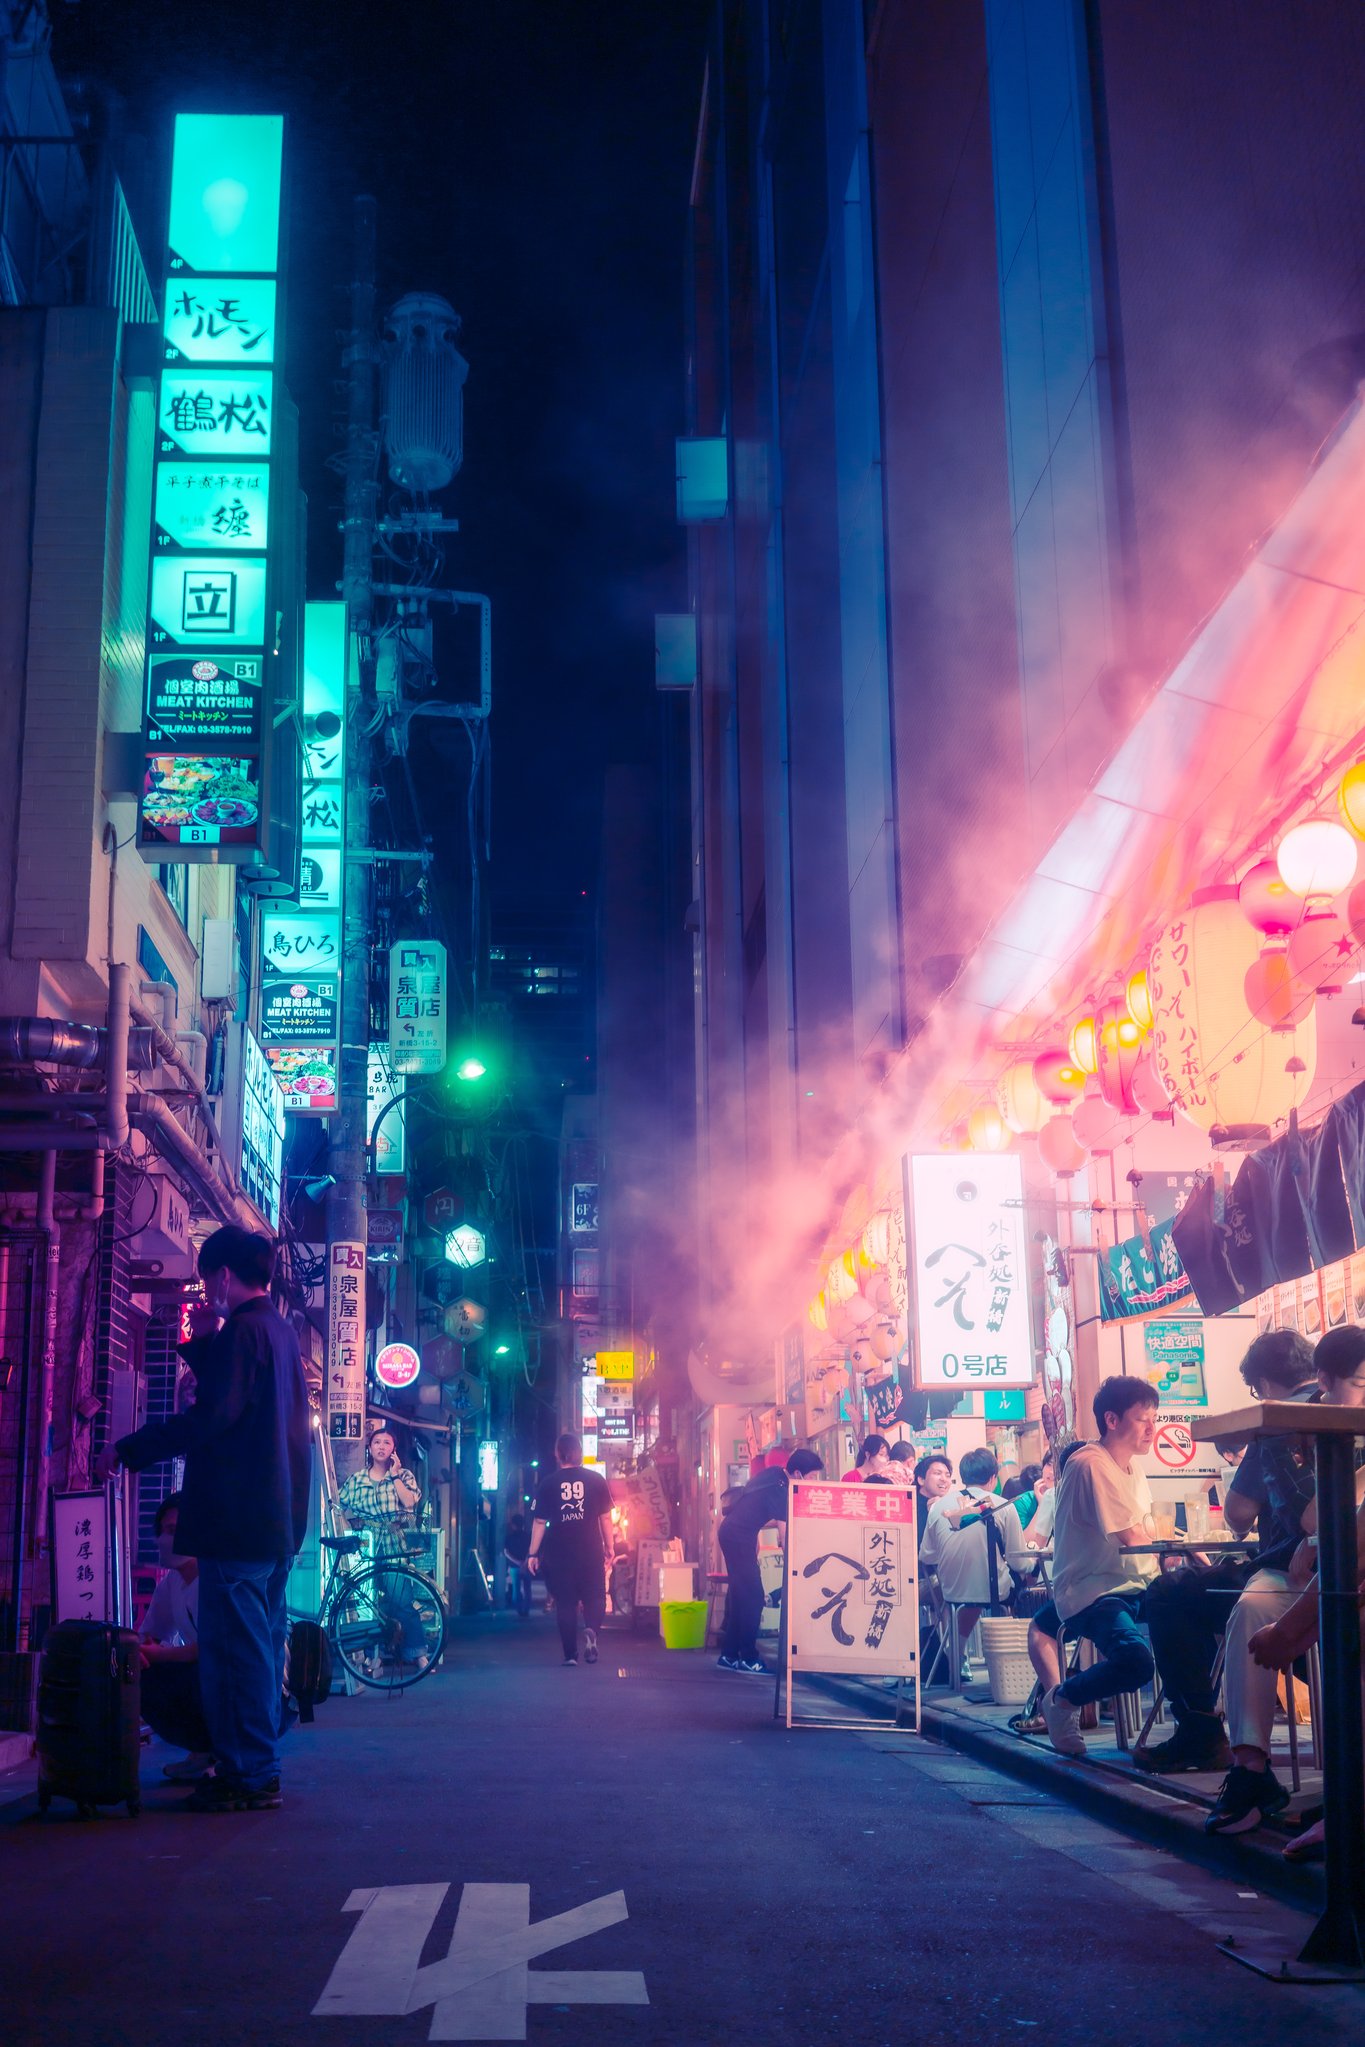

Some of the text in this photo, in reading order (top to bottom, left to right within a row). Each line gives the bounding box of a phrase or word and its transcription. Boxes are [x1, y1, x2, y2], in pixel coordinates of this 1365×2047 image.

[174, 290, 269, 350] ホルモン
[166, 390, 268, 436] 鶴松
[212, 498, 252, 538] 纏
[187, 582, 228, 620] 立
[236, 664, 256, 676] B1
[165, 680, 240, 695] 個室肉酒場
[156, 696, 254, 709] MEAT KITCHEN
[178, 711, 229, 721] ミートキッチン
[149, 730, 163, 740] B1
[191, 829, 208, 841] B1
[269, 931, 335, 957] 鳥ひろ
[319, 986, 332, 995] B1
[397, 976, 440, 994] 泉屋
[267, 1008, 331, 1017] MEAT KITCHEN
[396, 997, 440, 1018] 質店
[291, 1096, 303, 1106] B1
[987, 1218, 1014, 1283] 外呑処
[925, 1243, 987, 1331] へそ
[338, 1274, 359, 1366] 泉屋質店
[1147, 1334, 1203, 1351] 快適空間
[942, 1354, 1008, 1378] 0号店
[560, 1481, 584, 1501] 39
[560, 1499, 585, 1512] へそ
[806, 1489, 901, 1520] 営業中
[561, 1513, 584, 1522] JAPAN
[868, 1530, 897, 1598] 外呑処
[803, 1552, 871, 1647] へそ
[866, 1601, 893, 1646] 新橋
